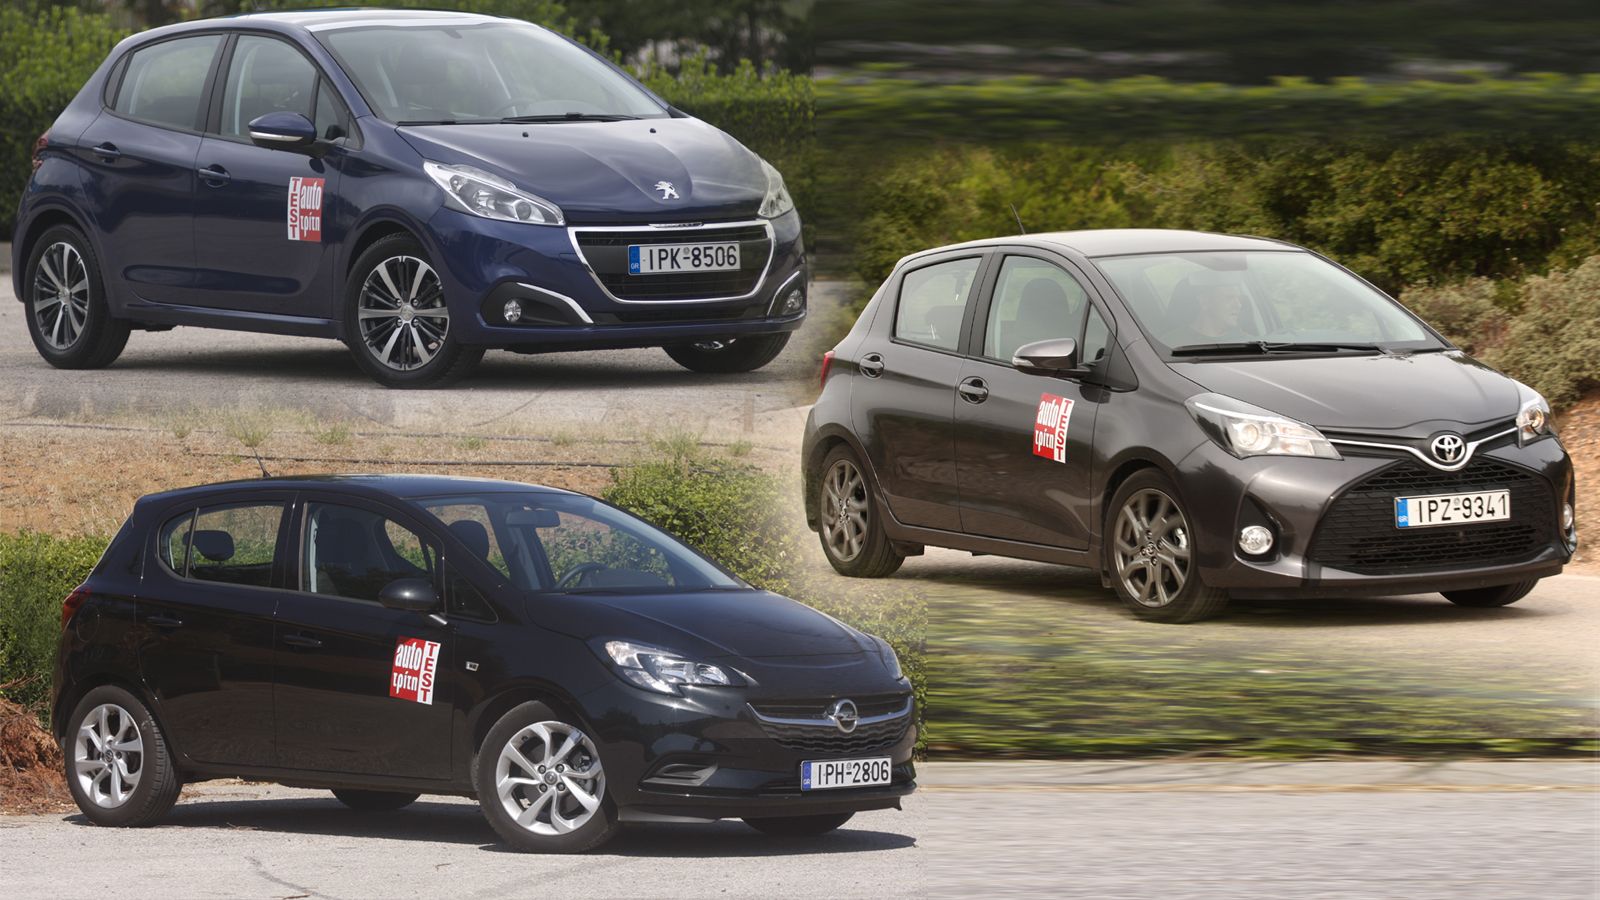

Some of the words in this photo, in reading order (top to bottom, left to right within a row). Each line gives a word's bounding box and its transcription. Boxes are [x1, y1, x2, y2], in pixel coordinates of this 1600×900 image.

[289, 178, 301, 239] TEST
[300, 180, 322, 210] auto
[630, 262, 640, 270] GR
[649, 245, 737, 271] IPK-8506
[1037, 399, 1060, 429] auto
[1056, 400, 1072, 461] TEST
[1418, 494, 1507, 523] IPZ-9341
[395, 642, 423, 671] auto
[420, 643, 438, 702] TEST
[818, 760, 890, 785] IPH-2806
